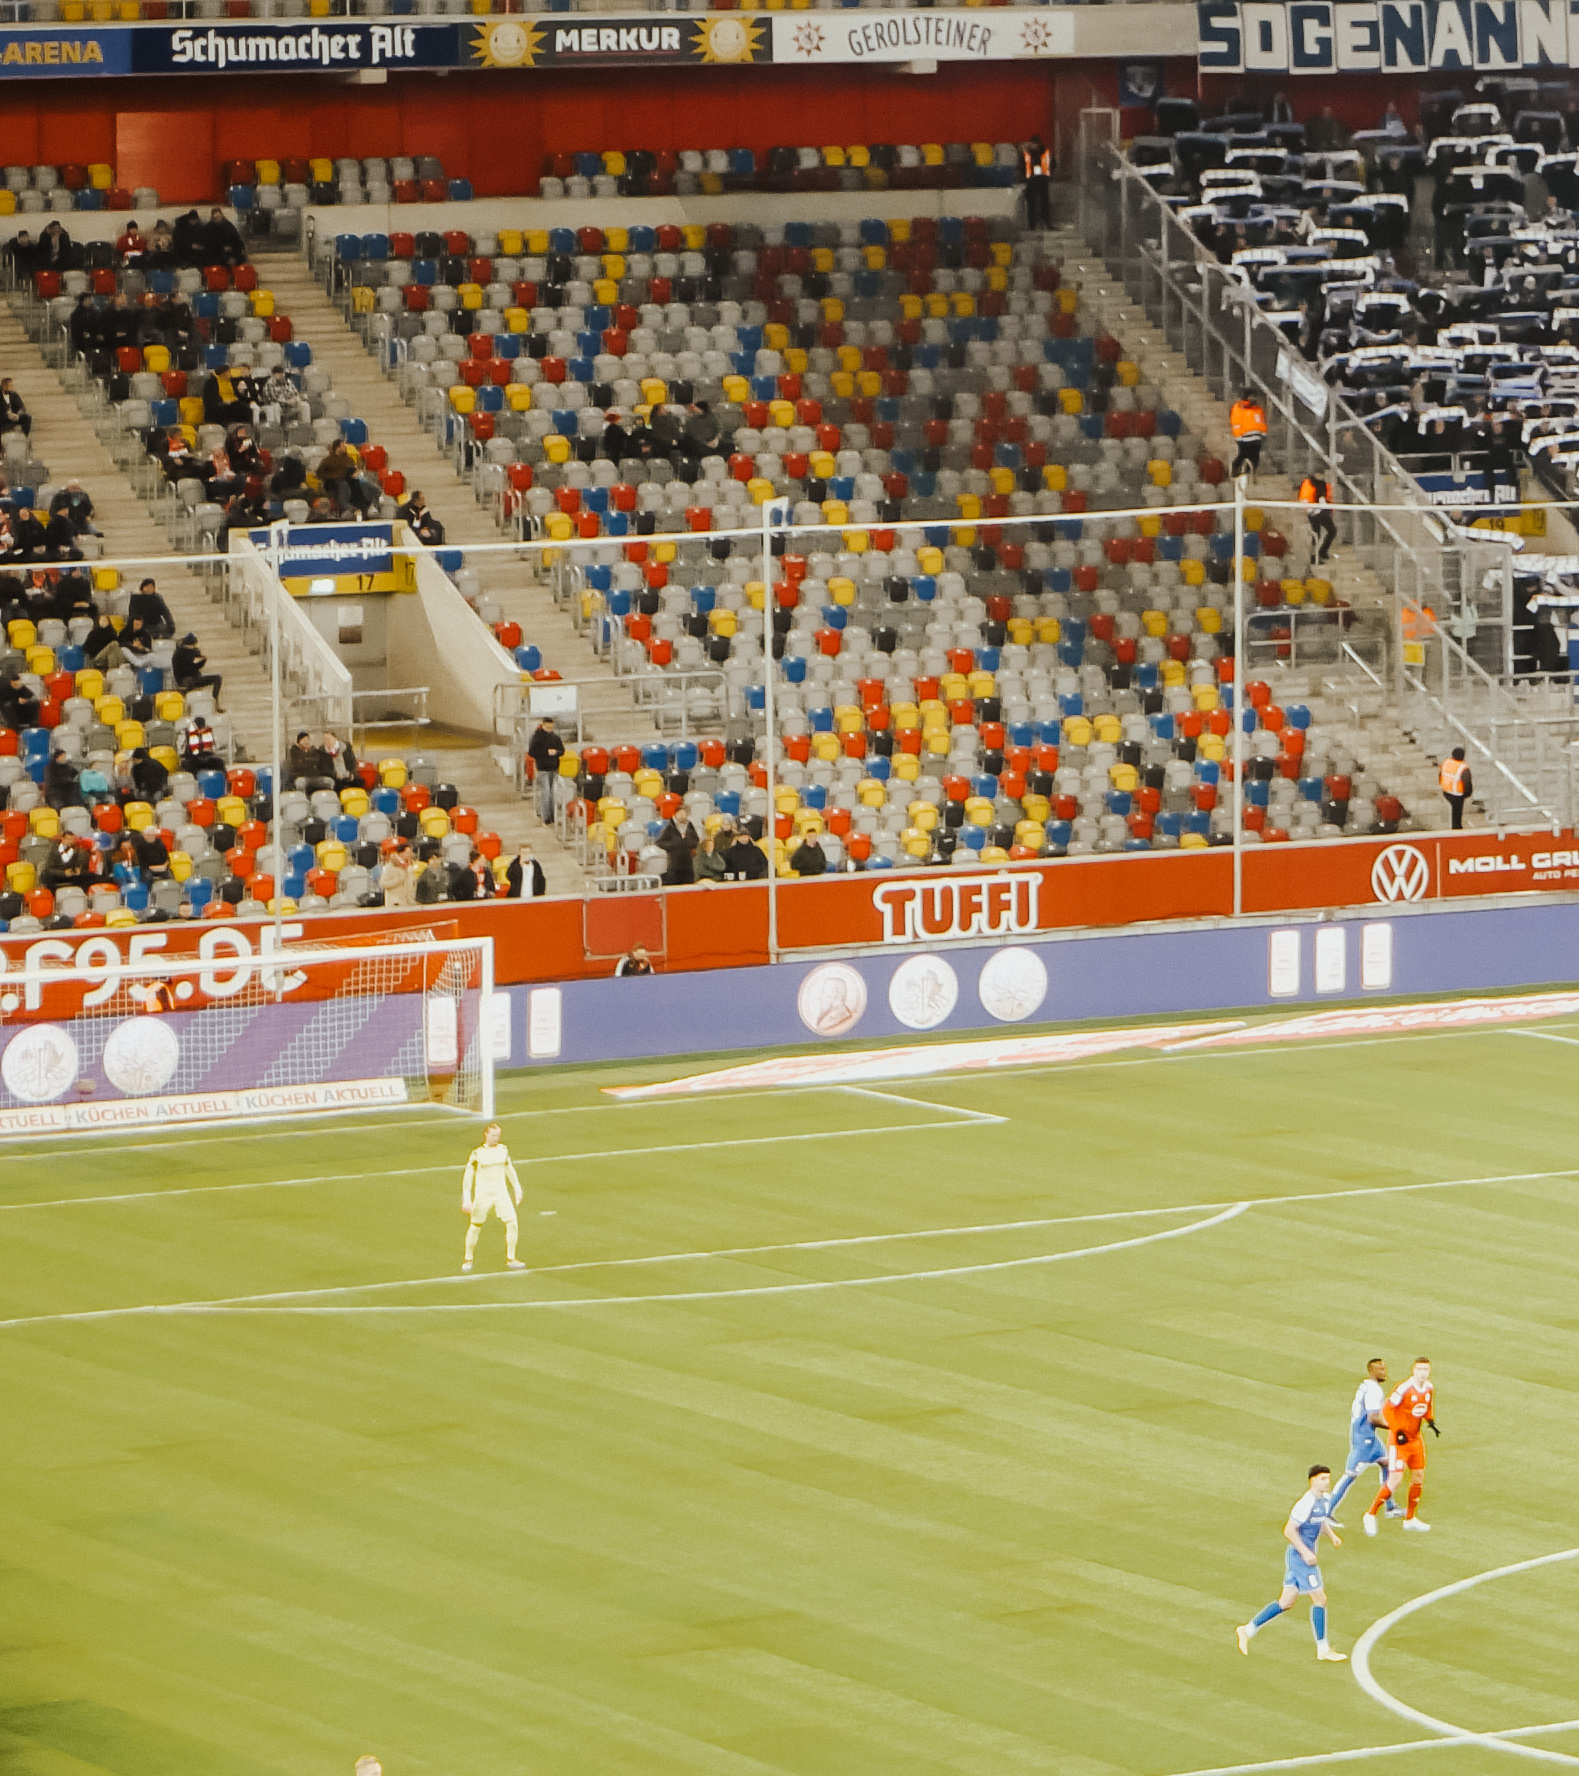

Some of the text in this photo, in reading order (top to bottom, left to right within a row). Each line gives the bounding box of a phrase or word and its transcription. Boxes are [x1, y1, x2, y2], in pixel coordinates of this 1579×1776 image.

[172, 26, 416, 68] Schumacher Alt
[554, 26, 680, 53] MERKUR
[848, 17, 992, 56] GEROLSTEINER
[1449, 853, 1527, 874] MOLL
[873, 872, 1044, 944] TUFFI
[246, 1084, 400, 1109] KÜCHEN AKTUELL
[75, 1105, 149, 1123] KÜCHEN
[156, 1099, 233, 1117] AKTUELL
